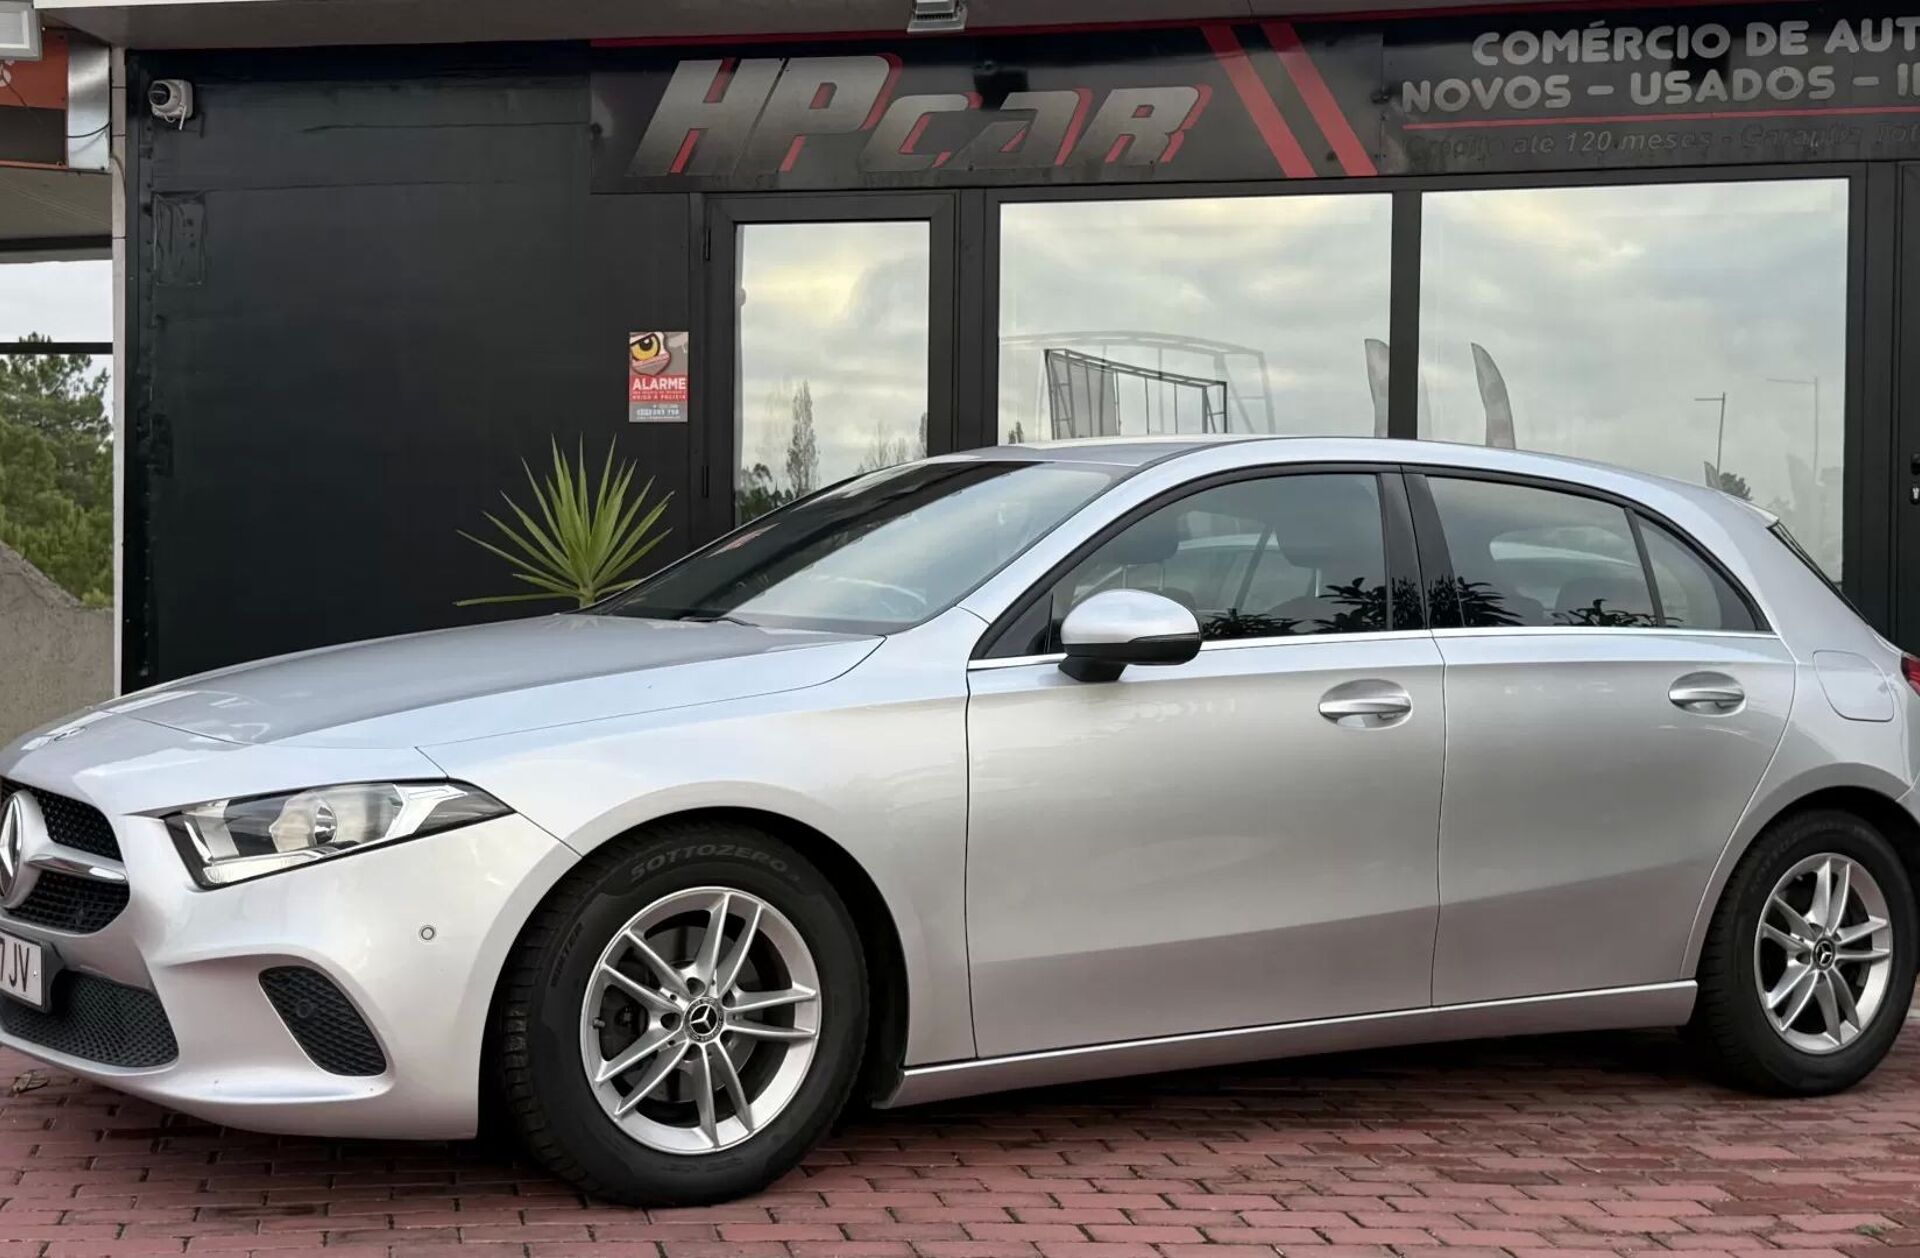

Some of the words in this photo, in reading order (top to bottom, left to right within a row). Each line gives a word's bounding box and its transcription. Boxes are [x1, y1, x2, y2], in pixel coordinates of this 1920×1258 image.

[1472, 19, 1731, 67] COMÉRCIO
[1745, 19, 1810, 58] DE
[1824, 15, 1920, 55] AUT
[1402, 73, 1572, 113] NOVOS
[1630, 65, 1836, 106] USADOS
[1566, 130, 1612, 152] 120
[632, 377, 687, 391] ALARME
[631, 843, 788, 883] SOTTOZERO
[9, 942, 30, 993] JV
